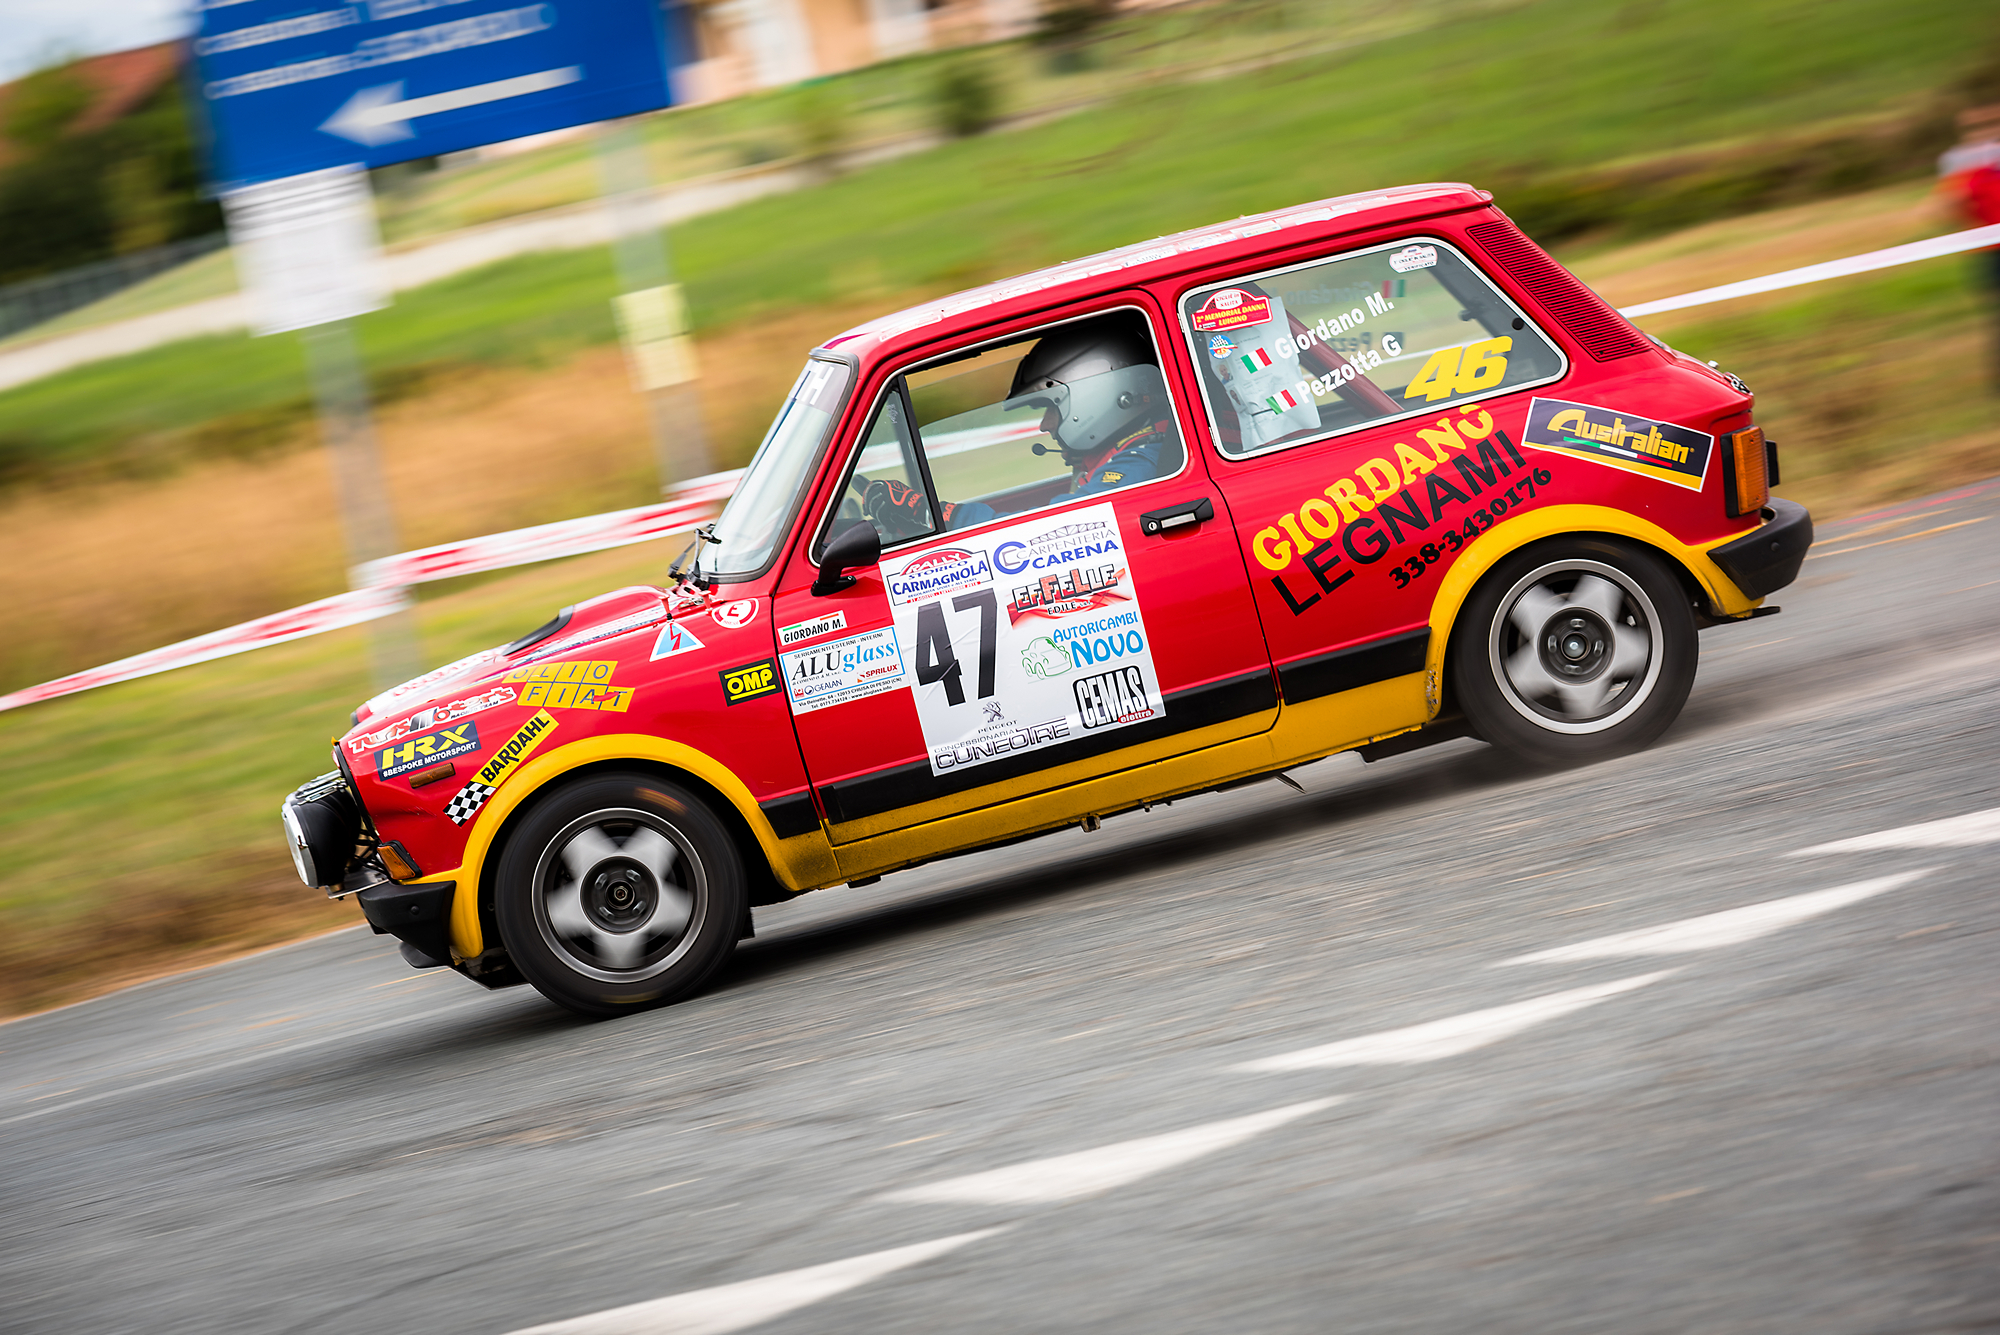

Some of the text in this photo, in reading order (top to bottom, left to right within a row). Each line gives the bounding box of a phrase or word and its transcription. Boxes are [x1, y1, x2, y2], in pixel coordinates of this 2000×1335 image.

[1204, 308, 1241, 321] MEMORIAL
[1242, 303, 1266, 313] DANNA
[1275, 308, 1365, 359] Giordano
[1365, 291, 1395, 317] M.
[1295, 350, 1383, 404] Pezzotta
[1381, 334, 1402, 358] G
[1404, 336, 1513, 402] 46
[1546, 408, 1692, 464] Australian
[1252, 404, 1494, 571] GIORDANO
[1270, 429, 1526, 617] LEGNAMI
[1389, 467, 1552, 590] 338-3430176
[1016, 529, 1116, 560] CARPENTERIA
[1032, 540, 1119, 569] CARENA
[892, 560, 988, 595] CARMAGNOLA
[906, 553, 962, 574] RALLY
[908, 560, 968, 580] STORICO
[726, 602, 744, 617] E
[1047, 601, 1077, 615] EDILE
[783, 618, 844, 643] GIORDANO M.
[1053, 611, 1139, 644] AUTORICAMBI
[791, 642, 895, 680] ALUglass
[794, 632, 883, 659] SERRAMENTI ESTERNI INTERNI
[915, 588, 998, 707] 47
[1070, 630, 1144, 668] NOVO
[513, 664, 609, 681] OLIO
[726, 668, 774, 695] OMP
[850, 685, 869, 693] CHIUSA
[875, 679, 890, 687] PESIO
[866, 664, 898, 677] SPRILUX
[526, 685, 628, 707] FIAT
[1076, 667, 1147, 728] CEMAS
[934, 728, 1015, 753] CONCESSIONARIA
[977, 719, 1018, 734] PEUGEOT
[381, 723, 470, 770] HRX
[383, 741, 477, 778] #BESPOKE MOTORSPORT
[480, 716, 551, 784] BARDAHL
